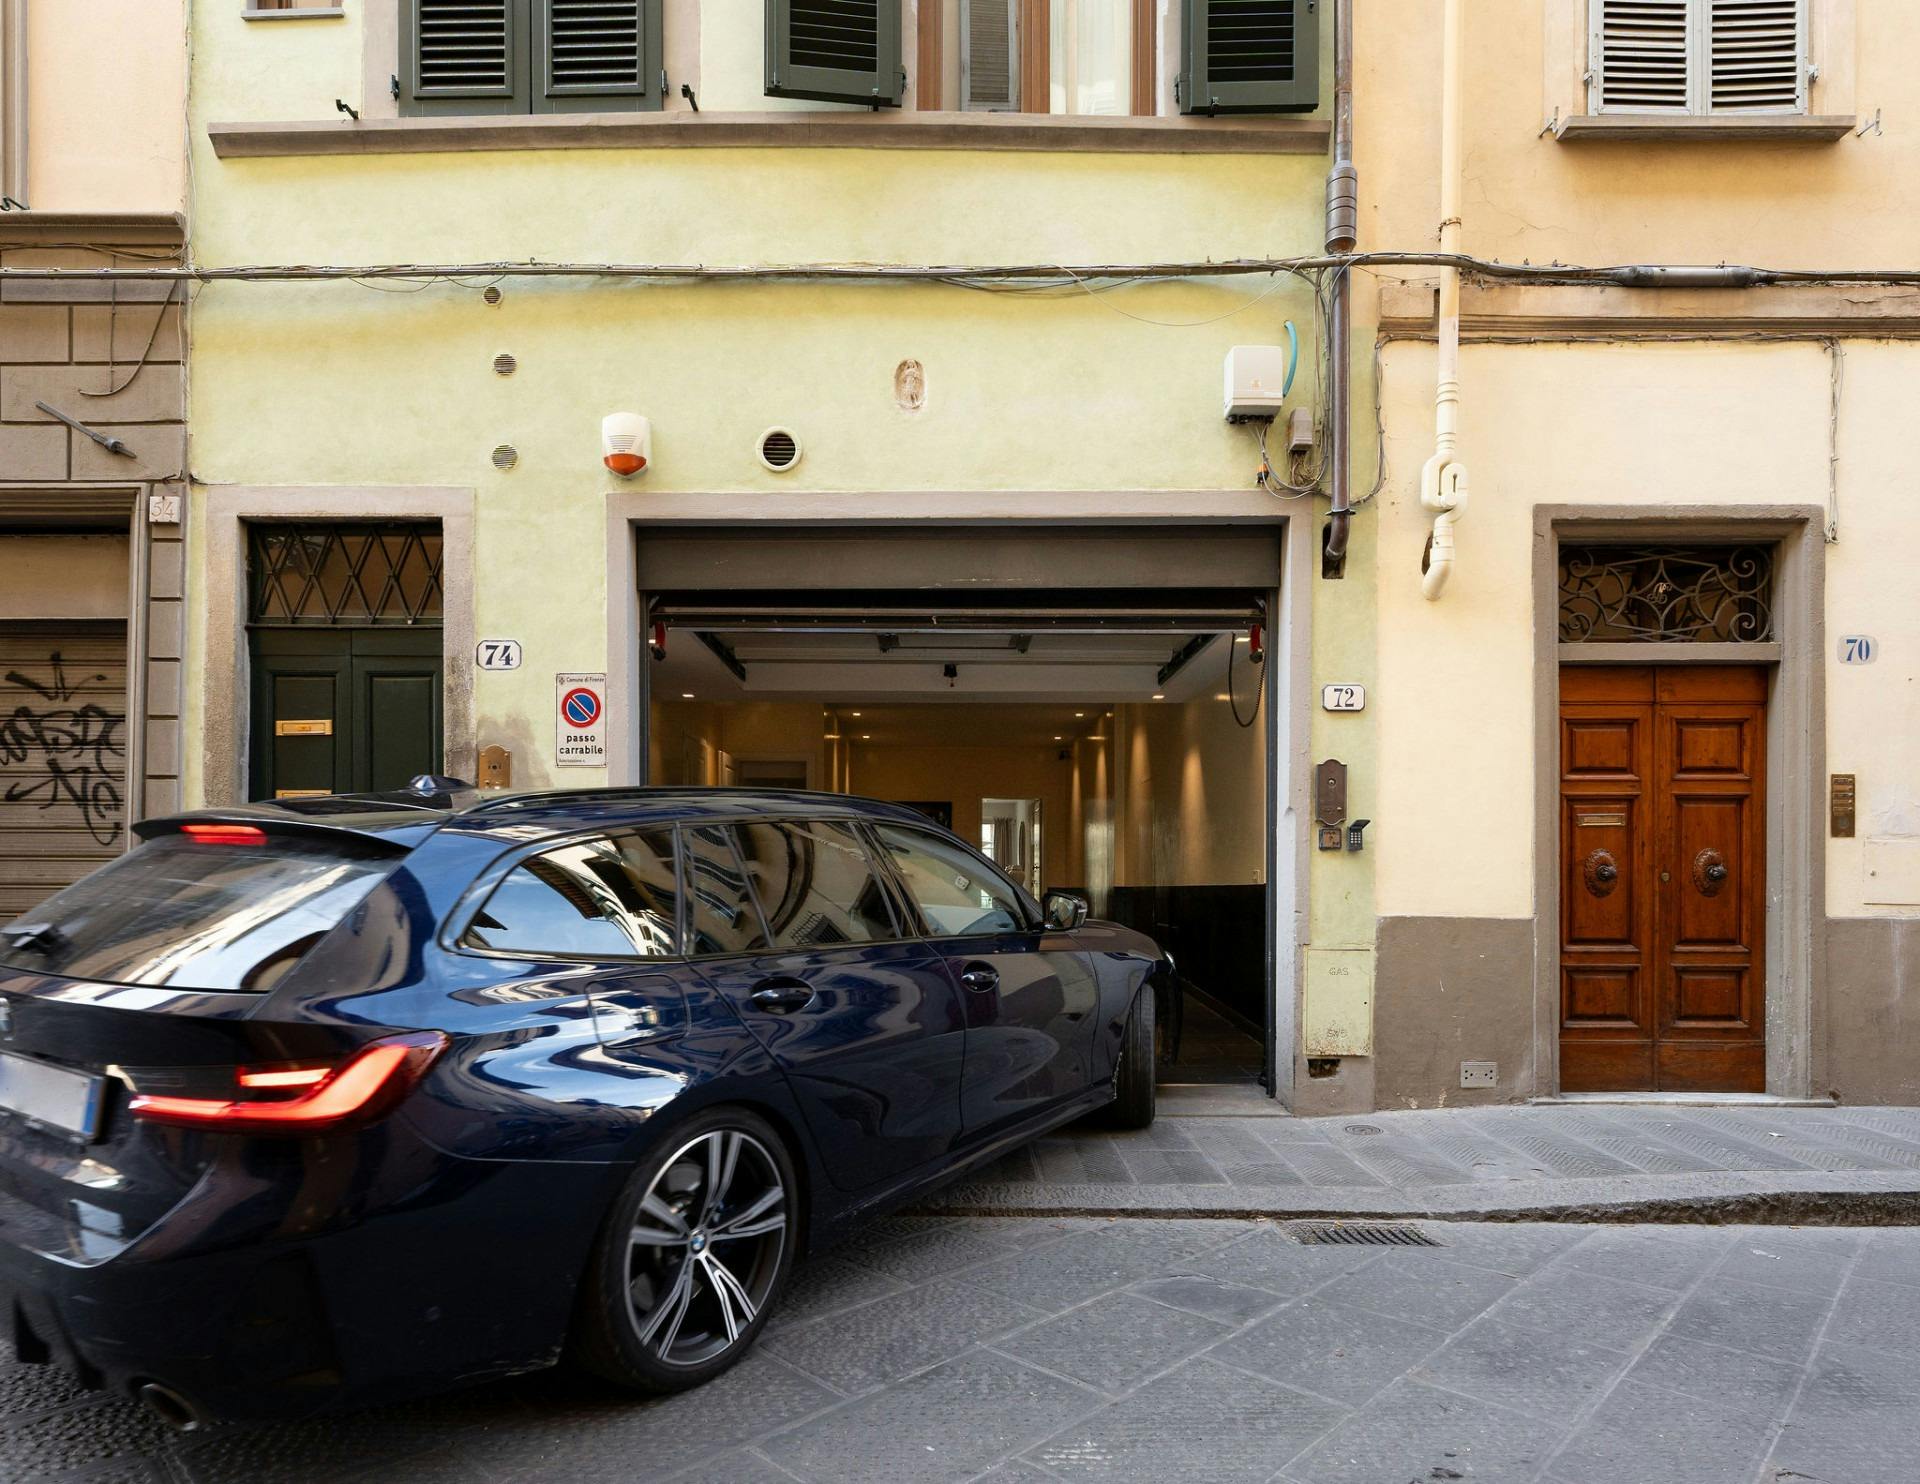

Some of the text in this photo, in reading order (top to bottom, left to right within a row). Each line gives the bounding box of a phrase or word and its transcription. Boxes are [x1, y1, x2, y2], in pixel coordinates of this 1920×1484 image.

[485, 644, 514, 666] 74
[1846, 638, 1870, 661] 70
[1333, 687, 1355, 708] 72
[566, 735, 596, 744] passo
[559, 745, 603, 755] carrabile
[1328, 966, 1350, 976] GAS
